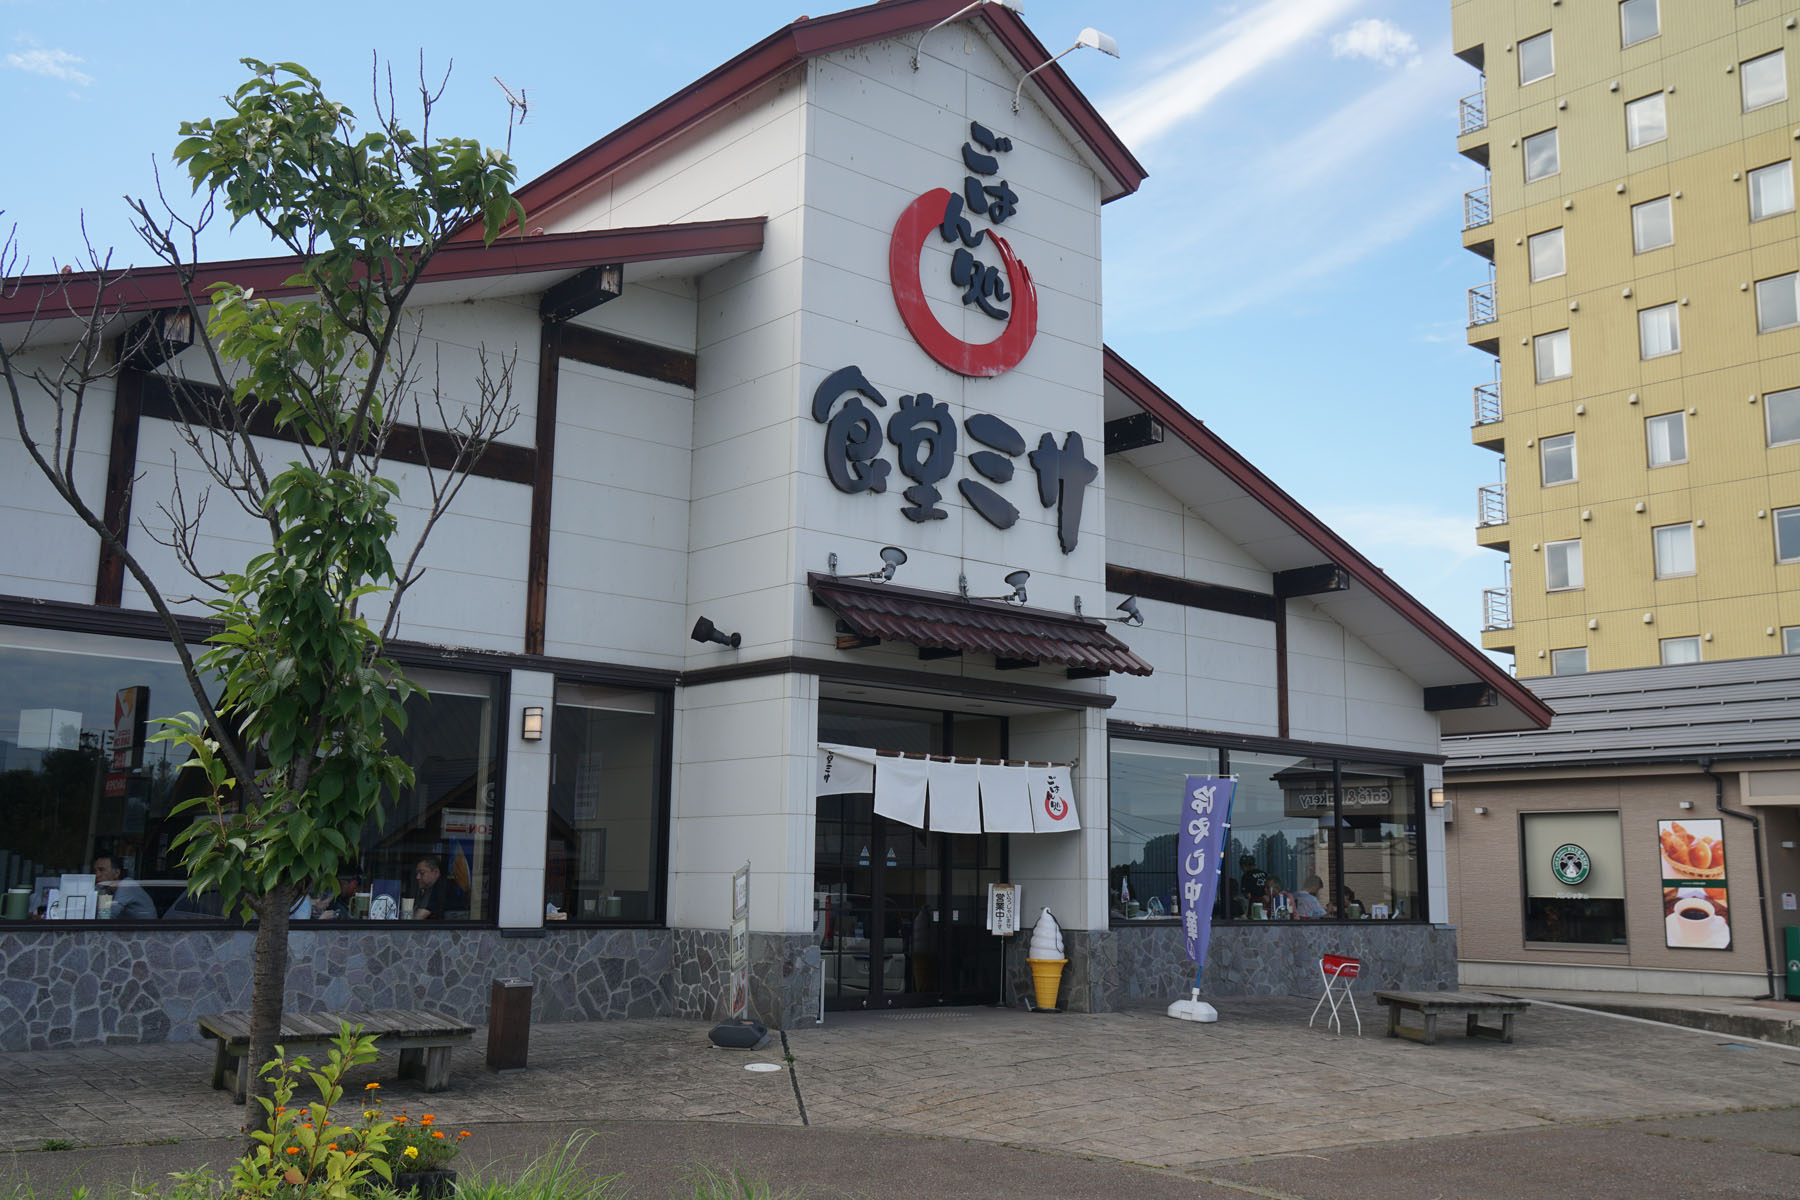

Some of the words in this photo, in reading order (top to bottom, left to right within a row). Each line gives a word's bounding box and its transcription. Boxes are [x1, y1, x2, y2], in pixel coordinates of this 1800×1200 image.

[940, 120, 1019, 320] ごはん処
[812, 365, 1099, 555] 食堂ミサ
[823, 751, 834, 784] 堂ミサ
[1046, 775, 1062, 811] ごはん処
[995, 893, 1005, 930] 営業中です
